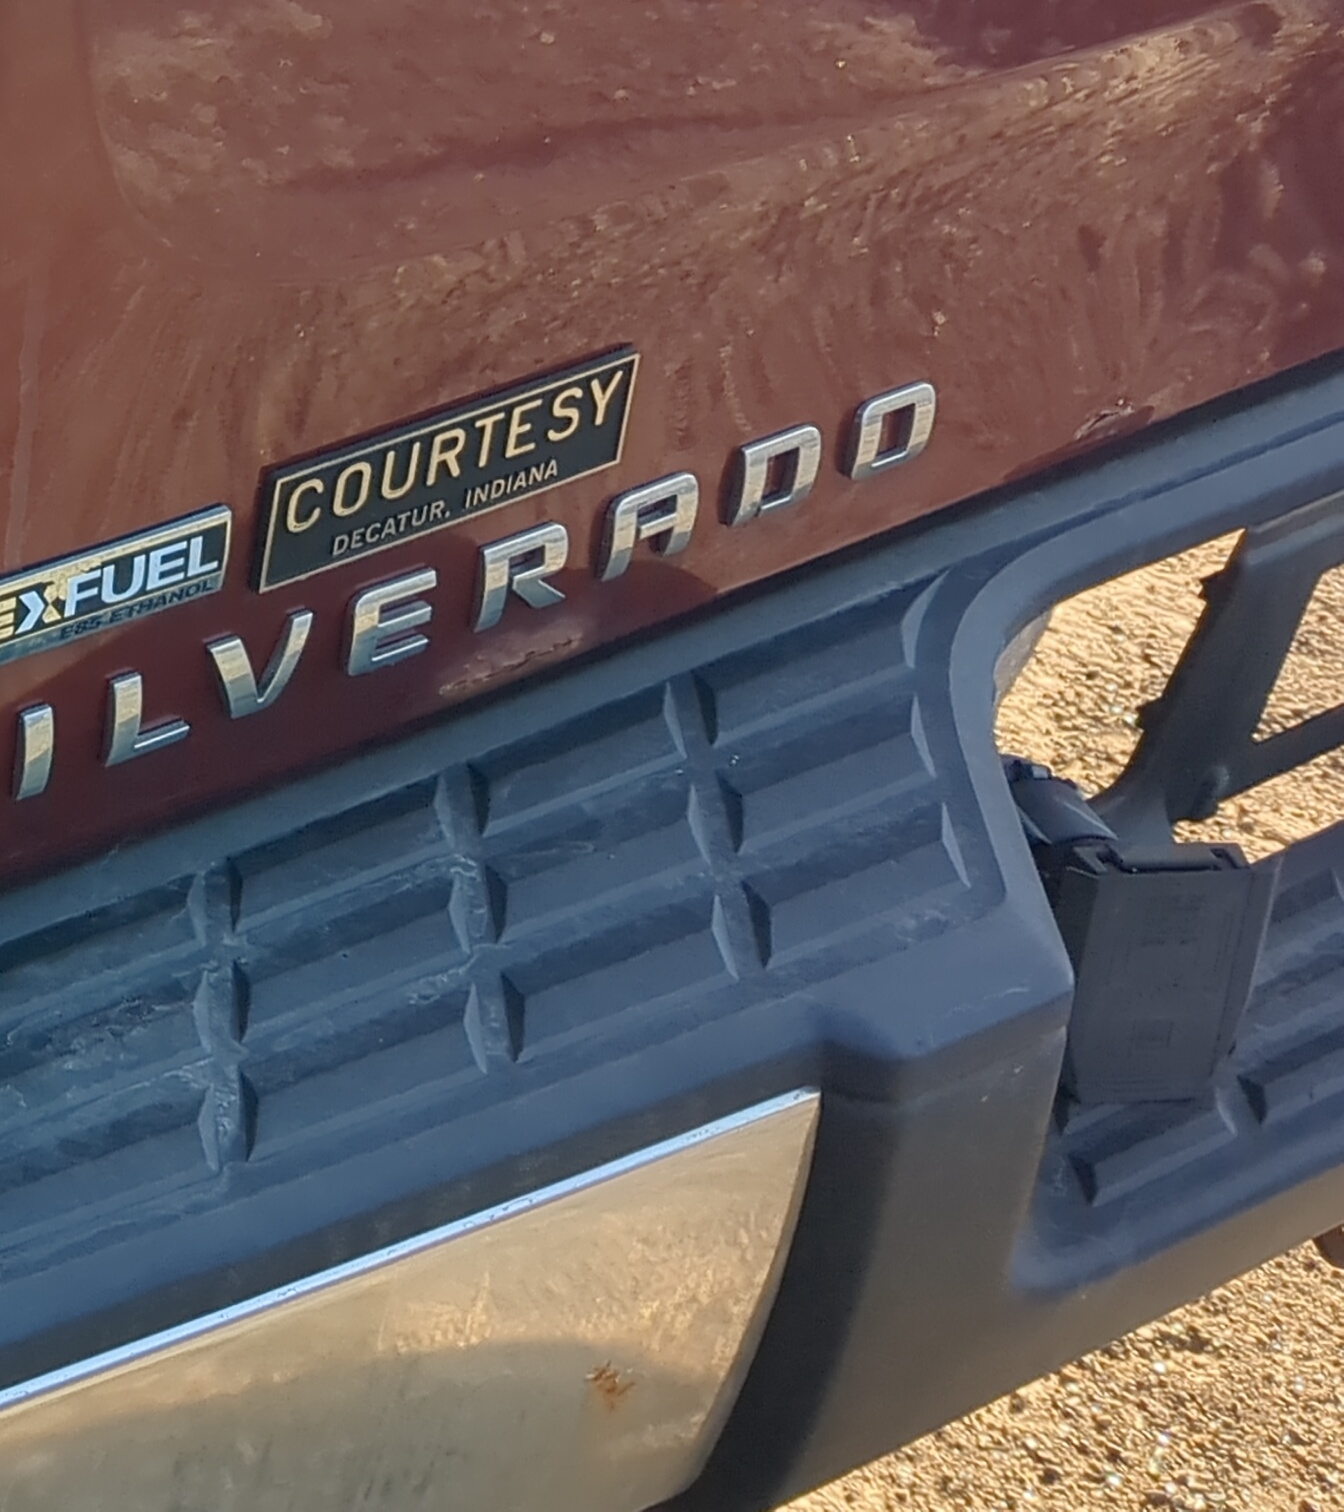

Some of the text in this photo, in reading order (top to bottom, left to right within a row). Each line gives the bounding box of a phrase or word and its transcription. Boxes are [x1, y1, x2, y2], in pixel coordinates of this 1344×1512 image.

[285, 369, 624, 535] COURTESY
[464, 458, 559, 508] INDIANA
[60, 578, 214, 640] E85 ETHANOL
